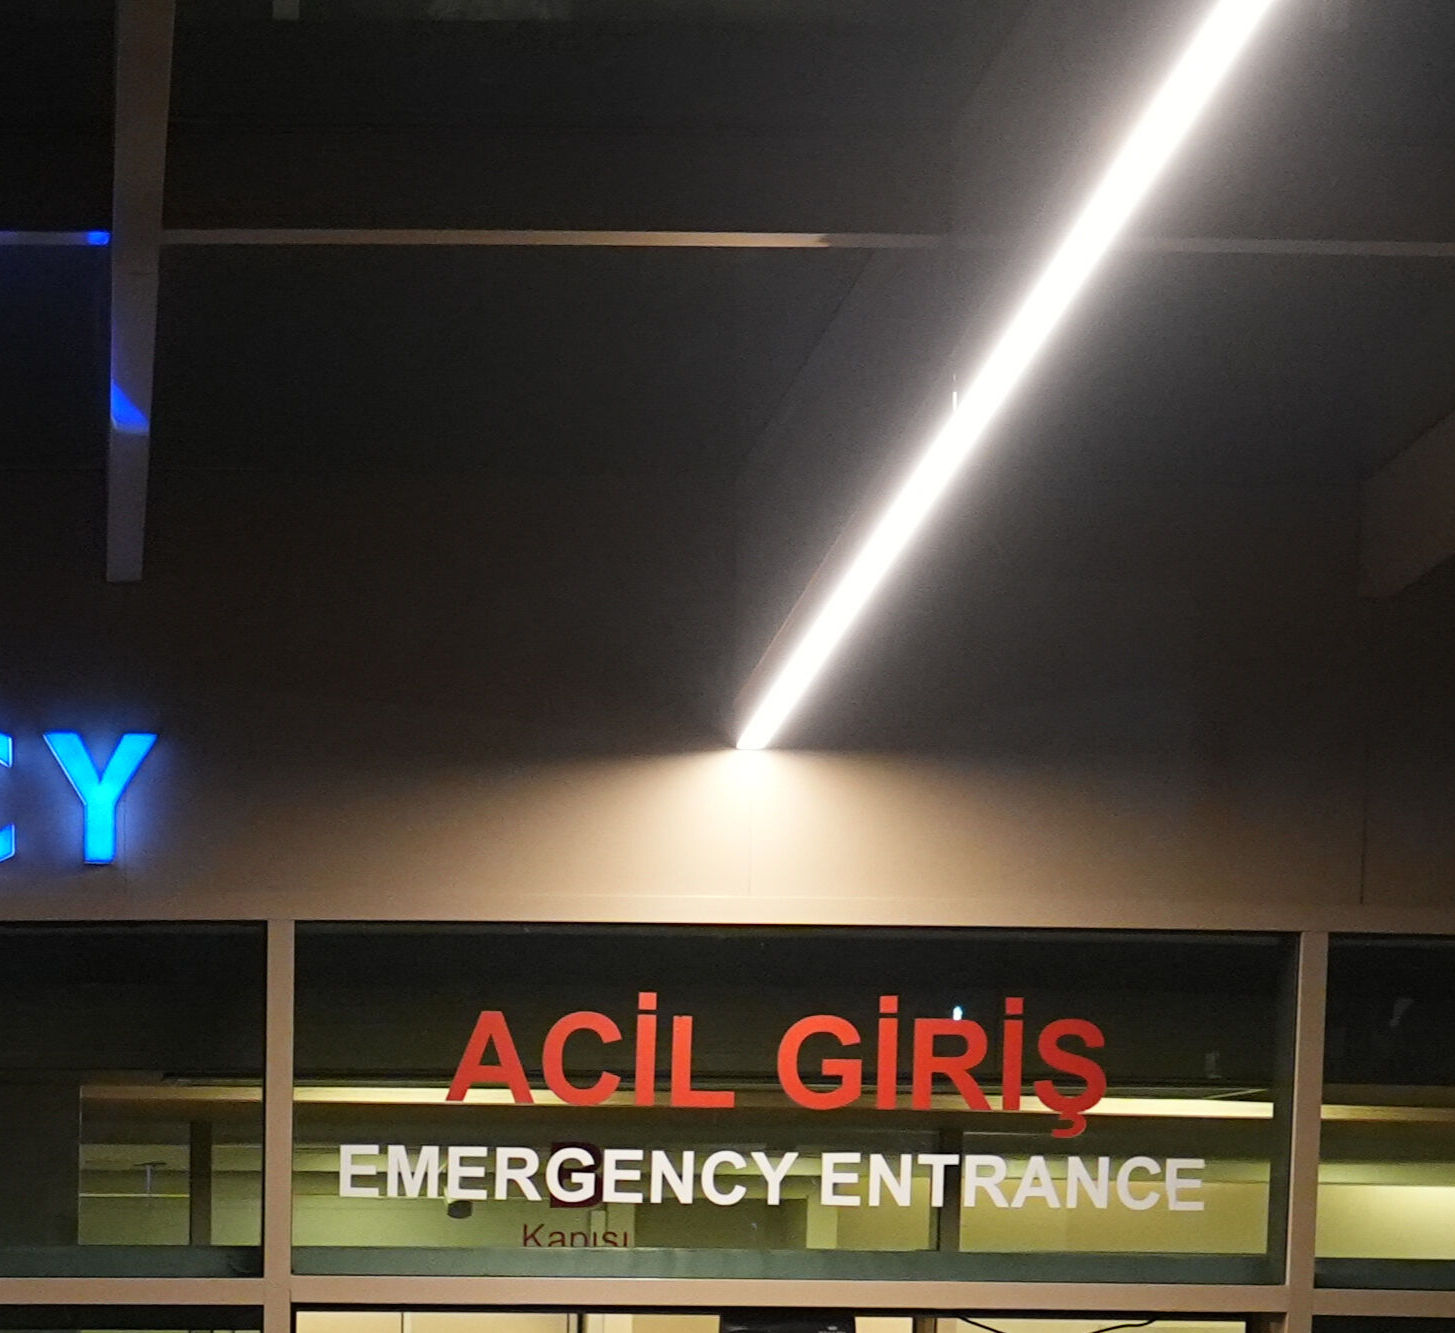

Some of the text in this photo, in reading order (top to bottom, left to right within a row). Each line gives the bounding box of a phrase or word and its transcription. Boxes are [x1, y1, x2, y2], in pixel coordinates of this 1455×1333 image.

[446, 991, 1108, 1137] ACİL GİRİŞ
[339, 1143, 1206, 1212] EMERGENCY ENTRANCE
